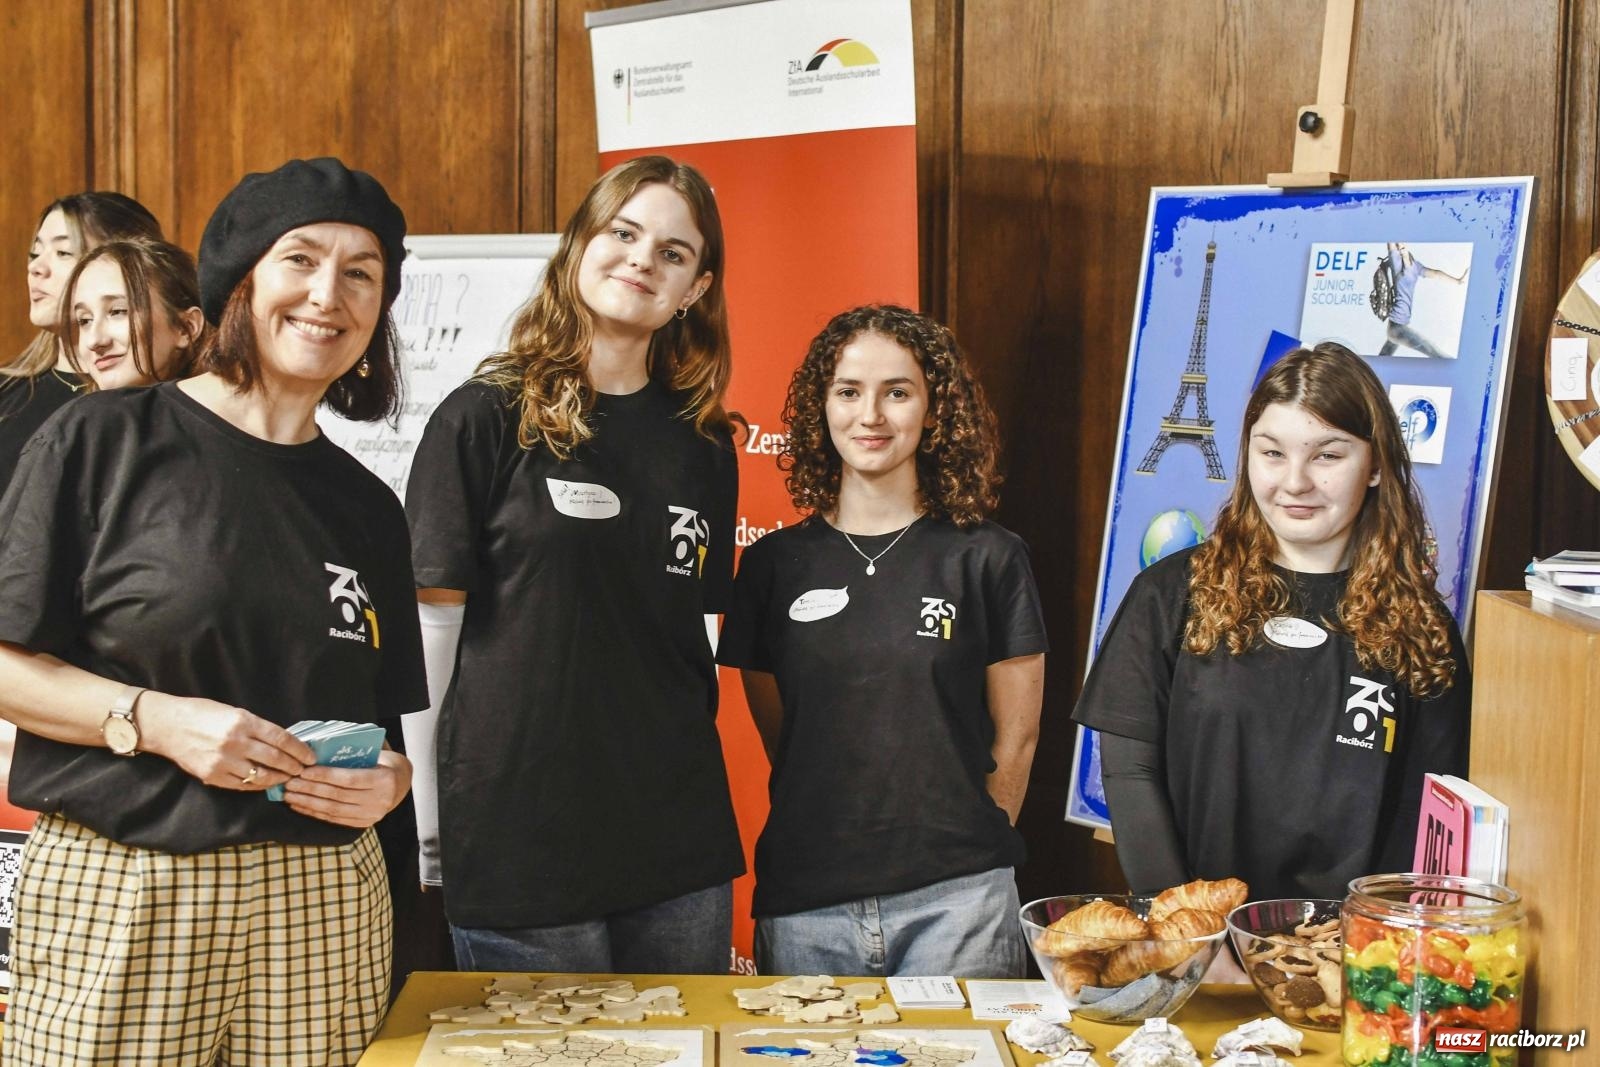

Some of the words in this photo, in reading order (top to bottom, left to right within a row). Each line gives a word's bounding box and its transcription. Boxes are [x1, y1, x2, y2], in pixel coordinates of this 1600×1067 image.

[1315, 251, 1368, 271] DELF
[1313, 279, 1355, 292] JUNIOR
[1311, 293, 1365, 306] SCOLAIRE
[1399, 415, 1420, 434] elf
[329, 627, 367, 643] Racibórz
[1336, 734, 1374, 750] Racibórz
